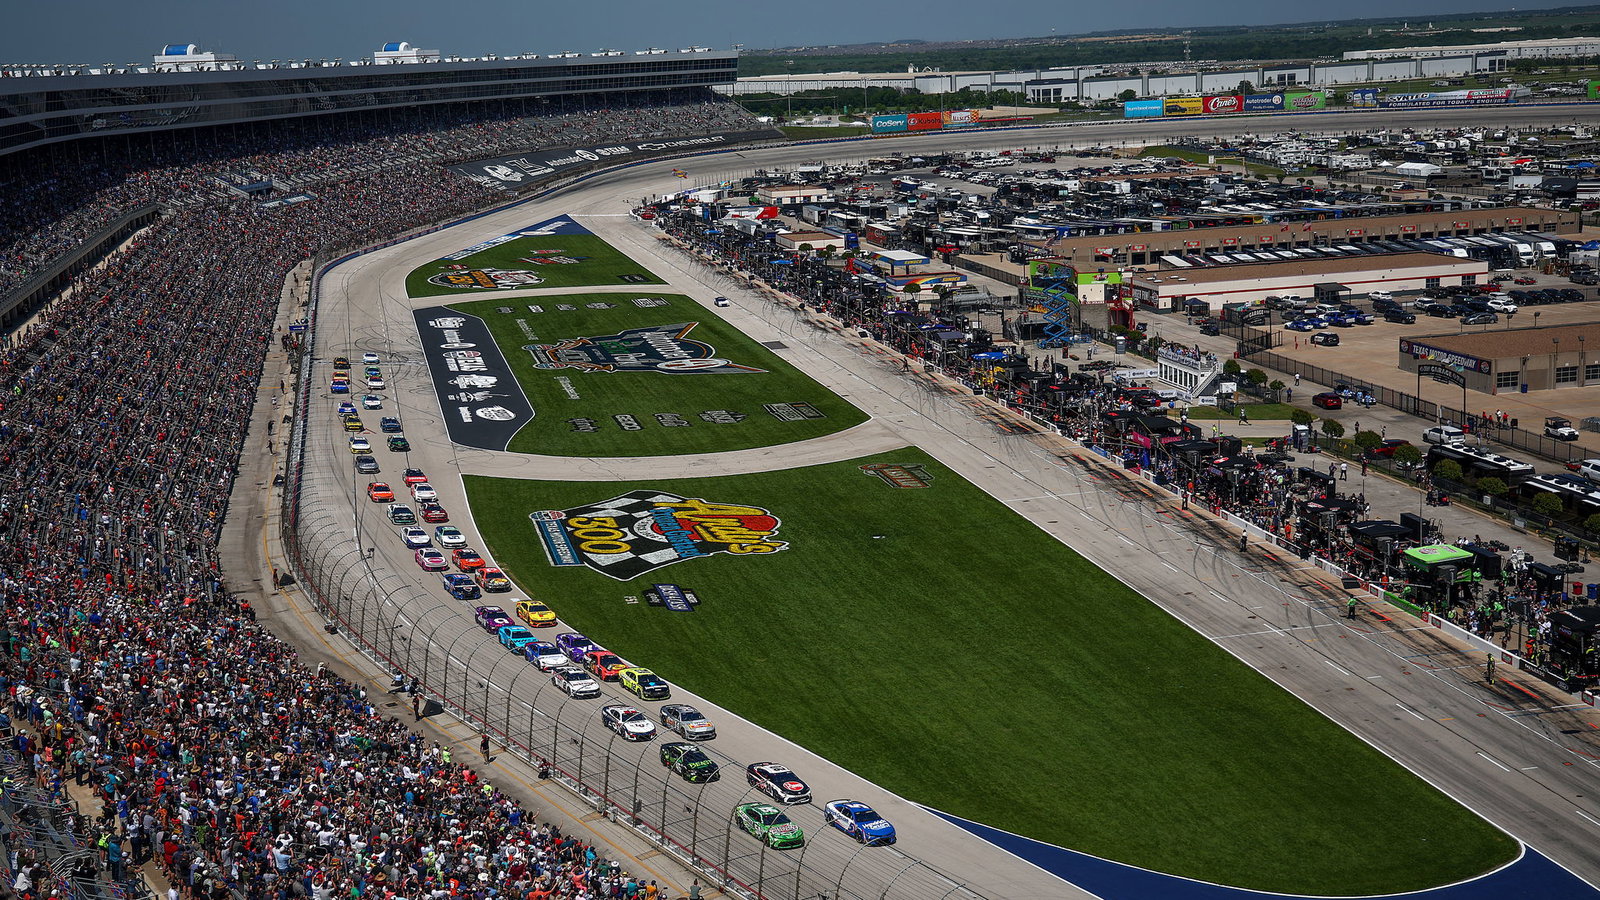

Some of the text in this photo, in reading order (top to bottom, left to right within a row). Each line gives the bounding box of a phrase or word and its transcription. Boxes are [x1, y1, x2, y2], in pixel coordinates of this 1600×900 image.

[1209, 97, 1237, 110] Cane's
[665, 136, 726, 148] CHEVROLET
[639, 331, 695, 360] Autotrader
[1412, 344, 1429, 357] TEXAS
[1448, 352, 1476, 369] SPEEDWAY
[567, 516, 632, 554] 300
[650, 508, 708, 557] Frozen Custard
[653, 499, 783, 553] Andy's
